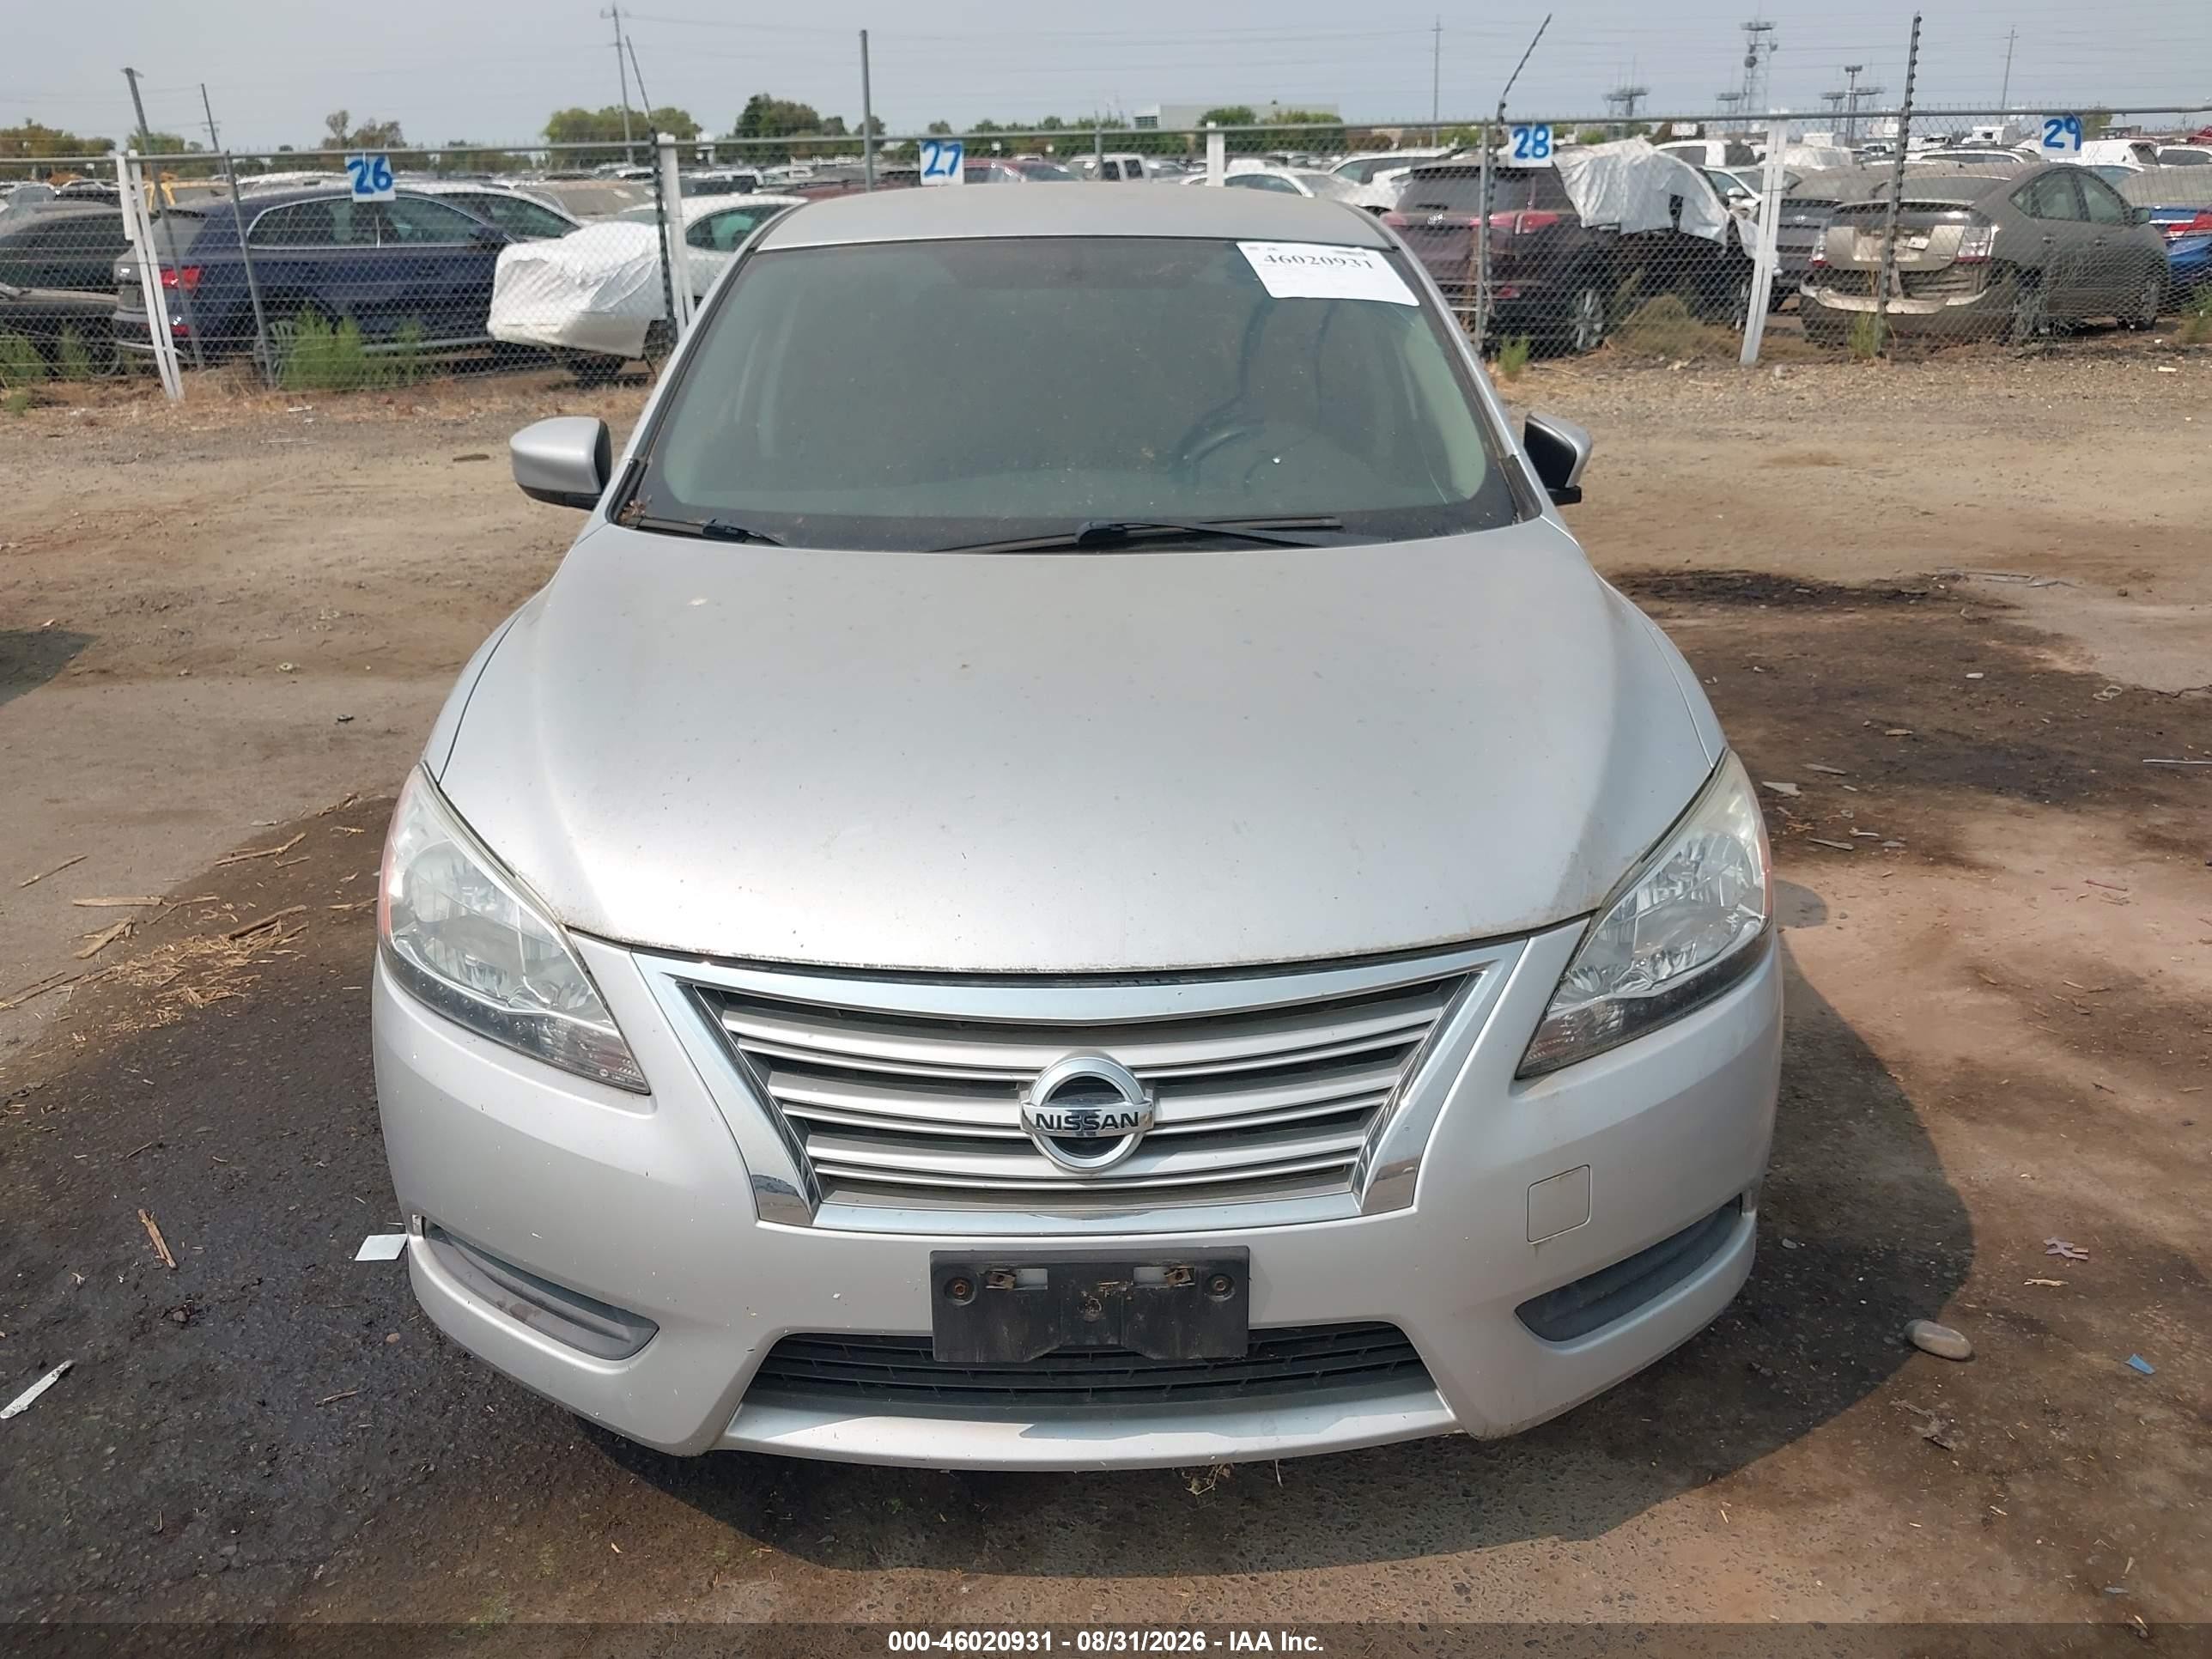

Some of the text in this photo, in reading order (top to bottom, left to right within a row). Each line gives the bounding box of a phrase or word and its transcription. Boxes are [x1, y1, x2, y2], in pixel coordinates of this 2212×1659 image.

[1513, 124, 1549, 159] 28
[2044, 115, 2082, 151] 29
[347, 155, 392, 194] 26
[923, 140, 961, 177] 27
[1264, 254, 1374, 270] 46020931
[1036, 1111, 1139, 1132] NISSAN
